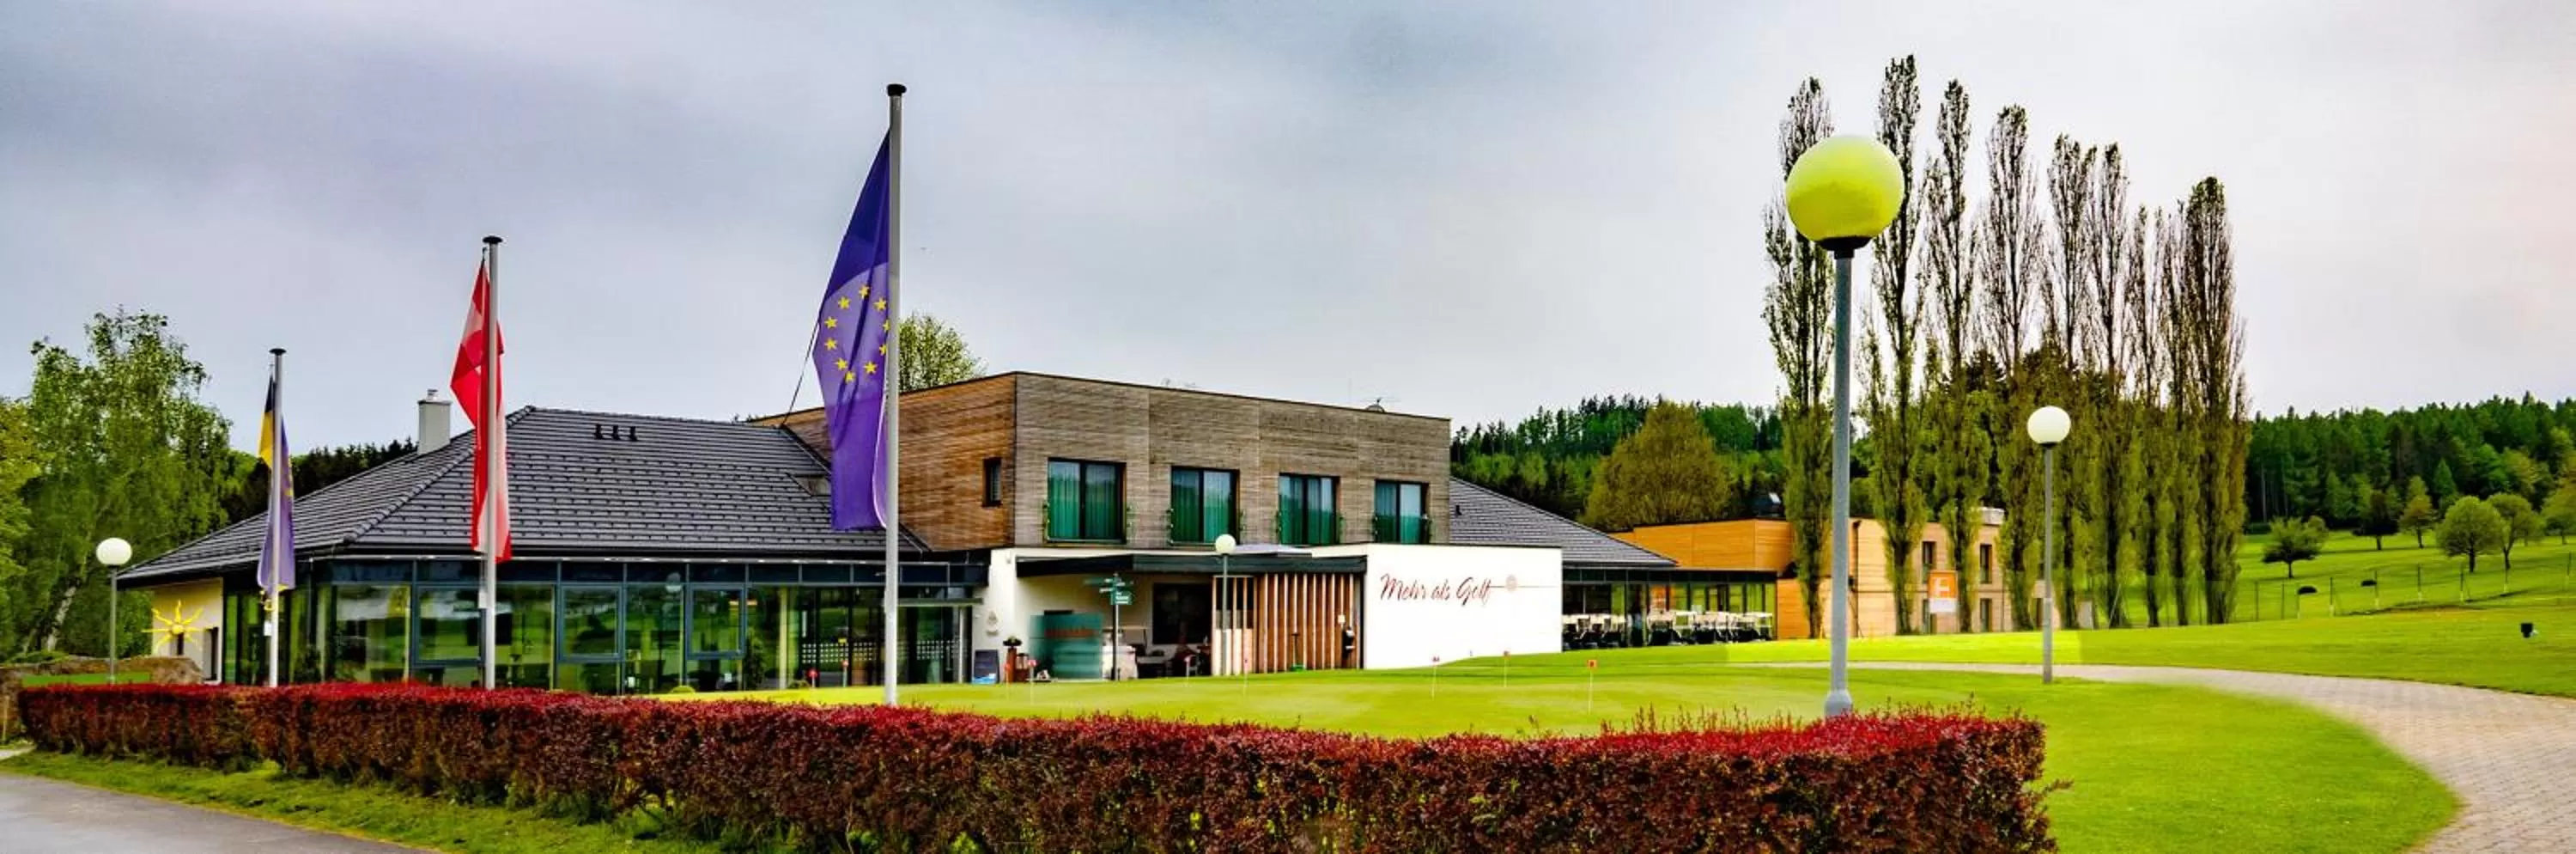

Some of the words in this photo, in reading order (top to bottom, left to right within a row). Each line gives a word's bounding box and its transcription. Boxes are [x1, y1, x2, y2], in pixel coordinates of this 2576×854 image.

[1380, 573, 1426, 601] Mehr
[1431, 578, 1450, 601] als
[1456, 576, 1492, 607] Golf
